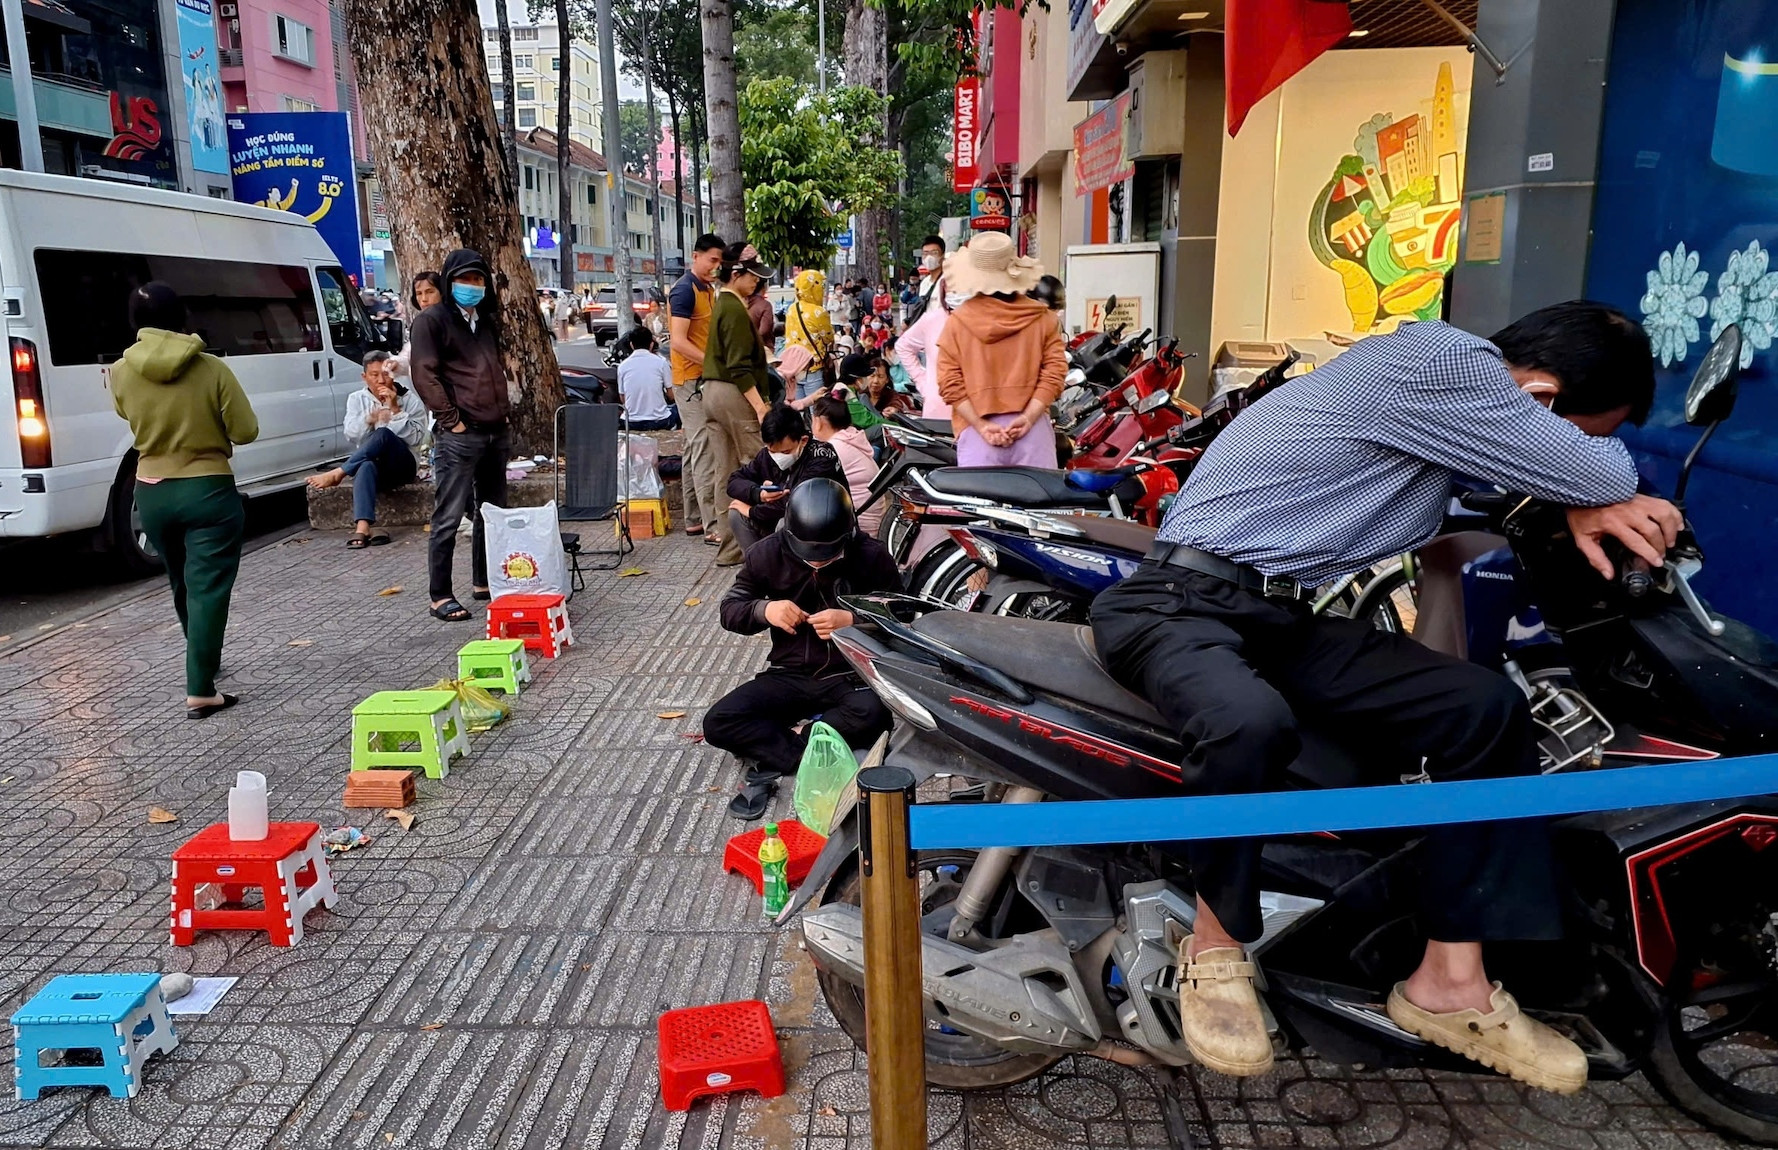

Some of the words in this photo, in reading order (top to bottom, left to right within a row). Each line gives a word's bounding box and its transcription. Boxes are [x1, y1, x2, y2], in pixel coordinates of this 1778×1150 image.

[958, 86, 974, 128] MART
[245, 135, 266, 147] HỌC
[267, 131, 295, 142] ĐÚNG
[957, 130, 973, 168] BIBO
[232, 145, 269, 163] LUYỆN
[271, 143, 314, 154] NHANH
[233, 161, 261, 175] NÂNG
[312, 157, 325, 168] SỐ
[321, 174, 339, 183] IELTS
[1034, 543, 1113, 566] VISION
[1476, 570, 1514, 581] HONDA
[949, 695, 1013, 724] AIR
[1018, 717, 1133, 768] BLADE
